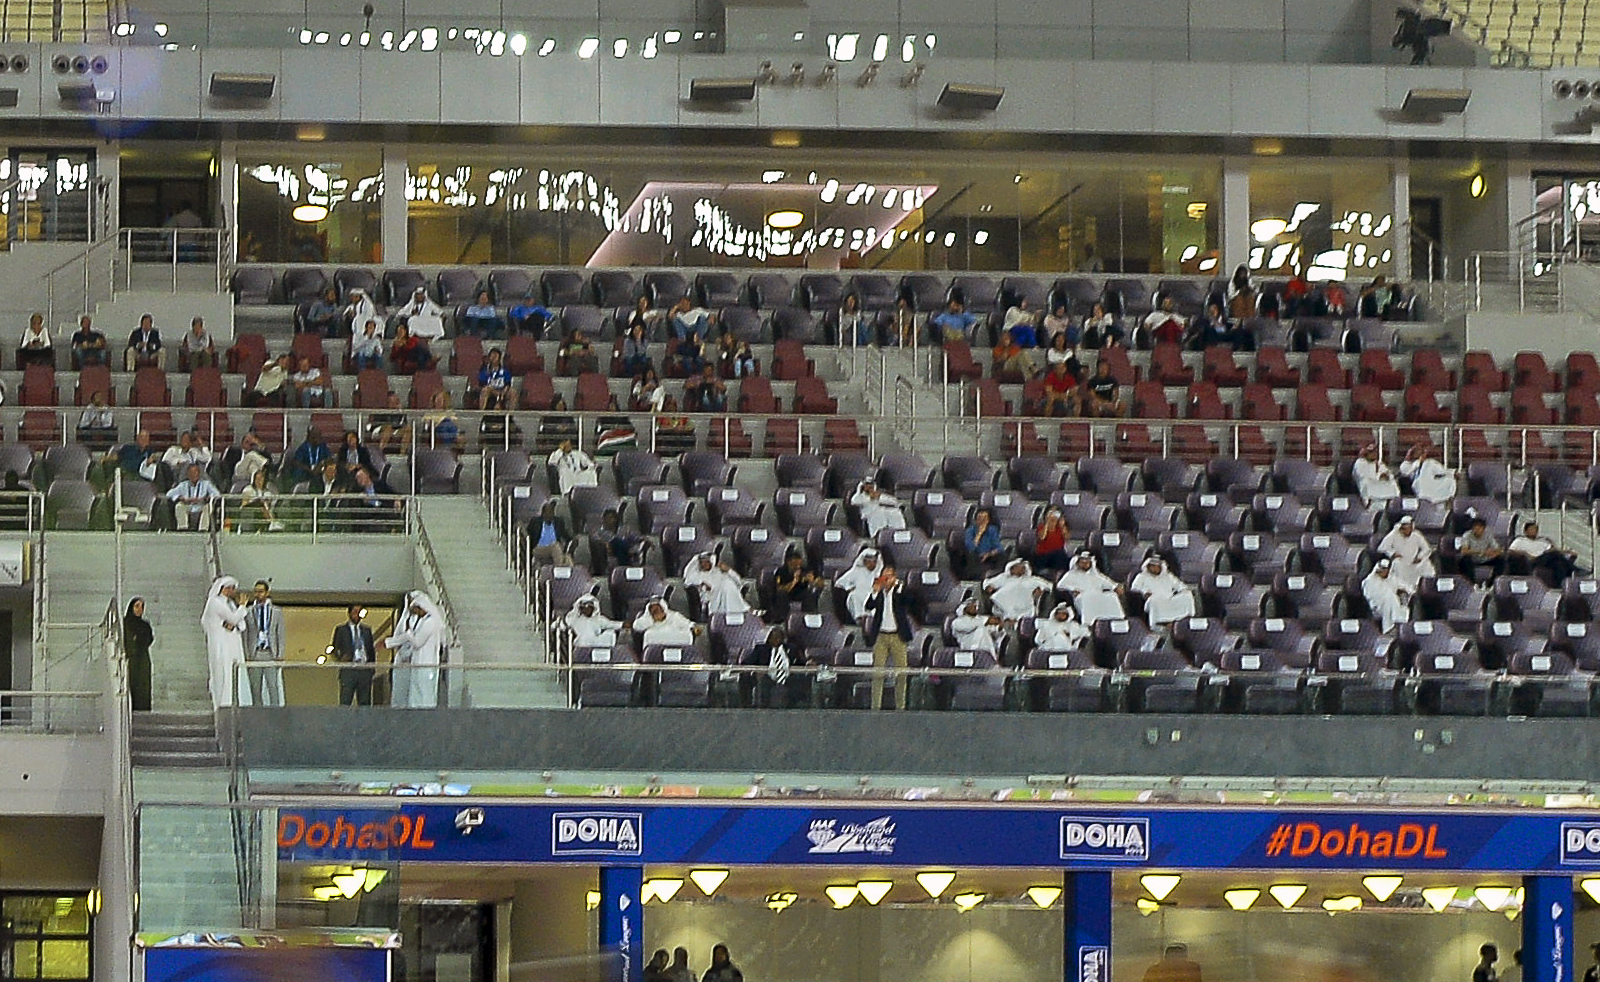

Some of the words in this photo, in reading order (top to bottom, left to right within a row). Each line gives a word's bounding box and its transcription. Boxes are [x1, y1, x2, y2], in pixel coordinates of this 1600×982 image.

[558, 818, 637, 842] DOHA
[1066, 823, 1144, 848] DOHA
[1266, 821, 1448, 857] #DohaDL
